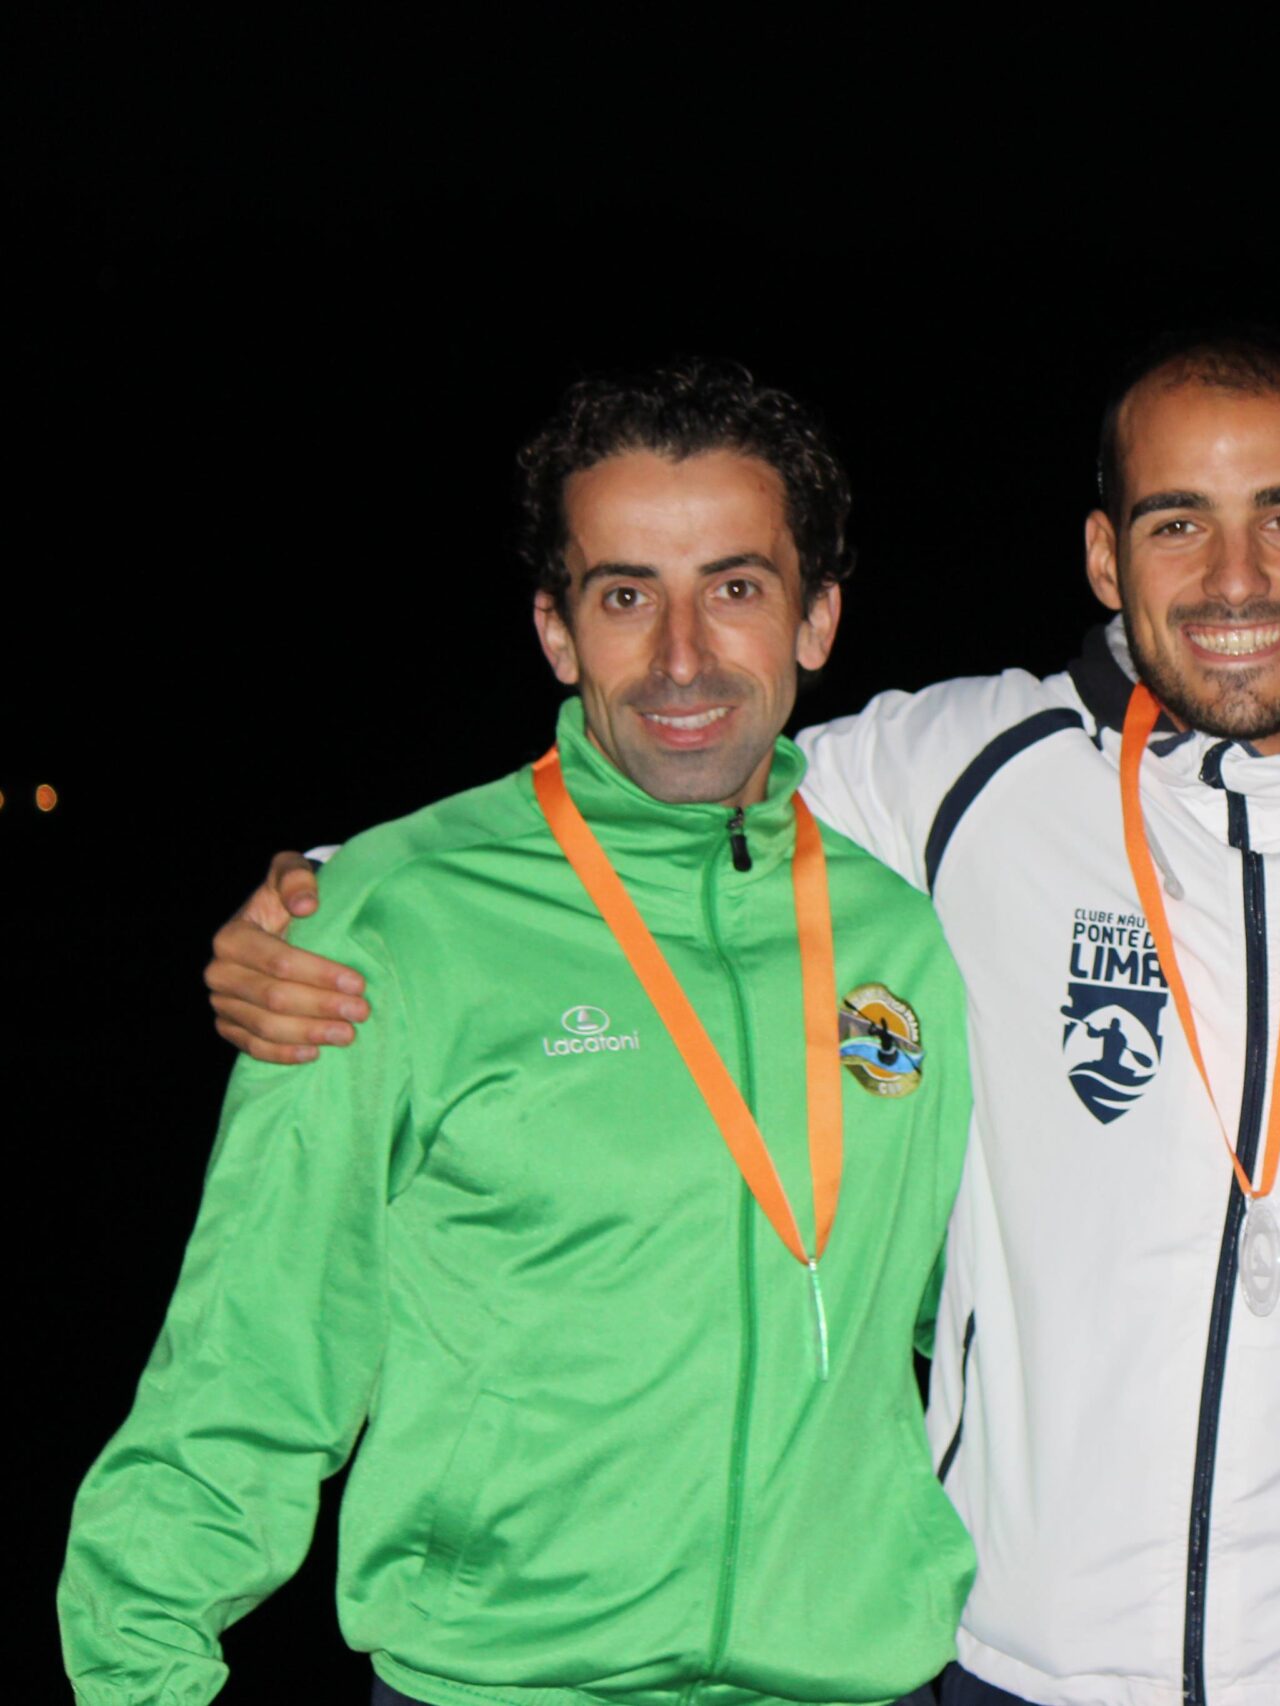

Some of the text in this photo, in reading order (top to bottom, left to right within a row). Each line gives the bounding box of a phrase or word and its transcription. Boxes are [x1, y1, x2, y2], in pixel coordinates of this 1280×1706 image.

[1074, 908, 1115, 924] CLUBE
[1072, 922, 1157, 950] PONTE D
[1069, 942, 1169, 988] LIMA
[543, 1029, 641, 1057] Lacatoni
